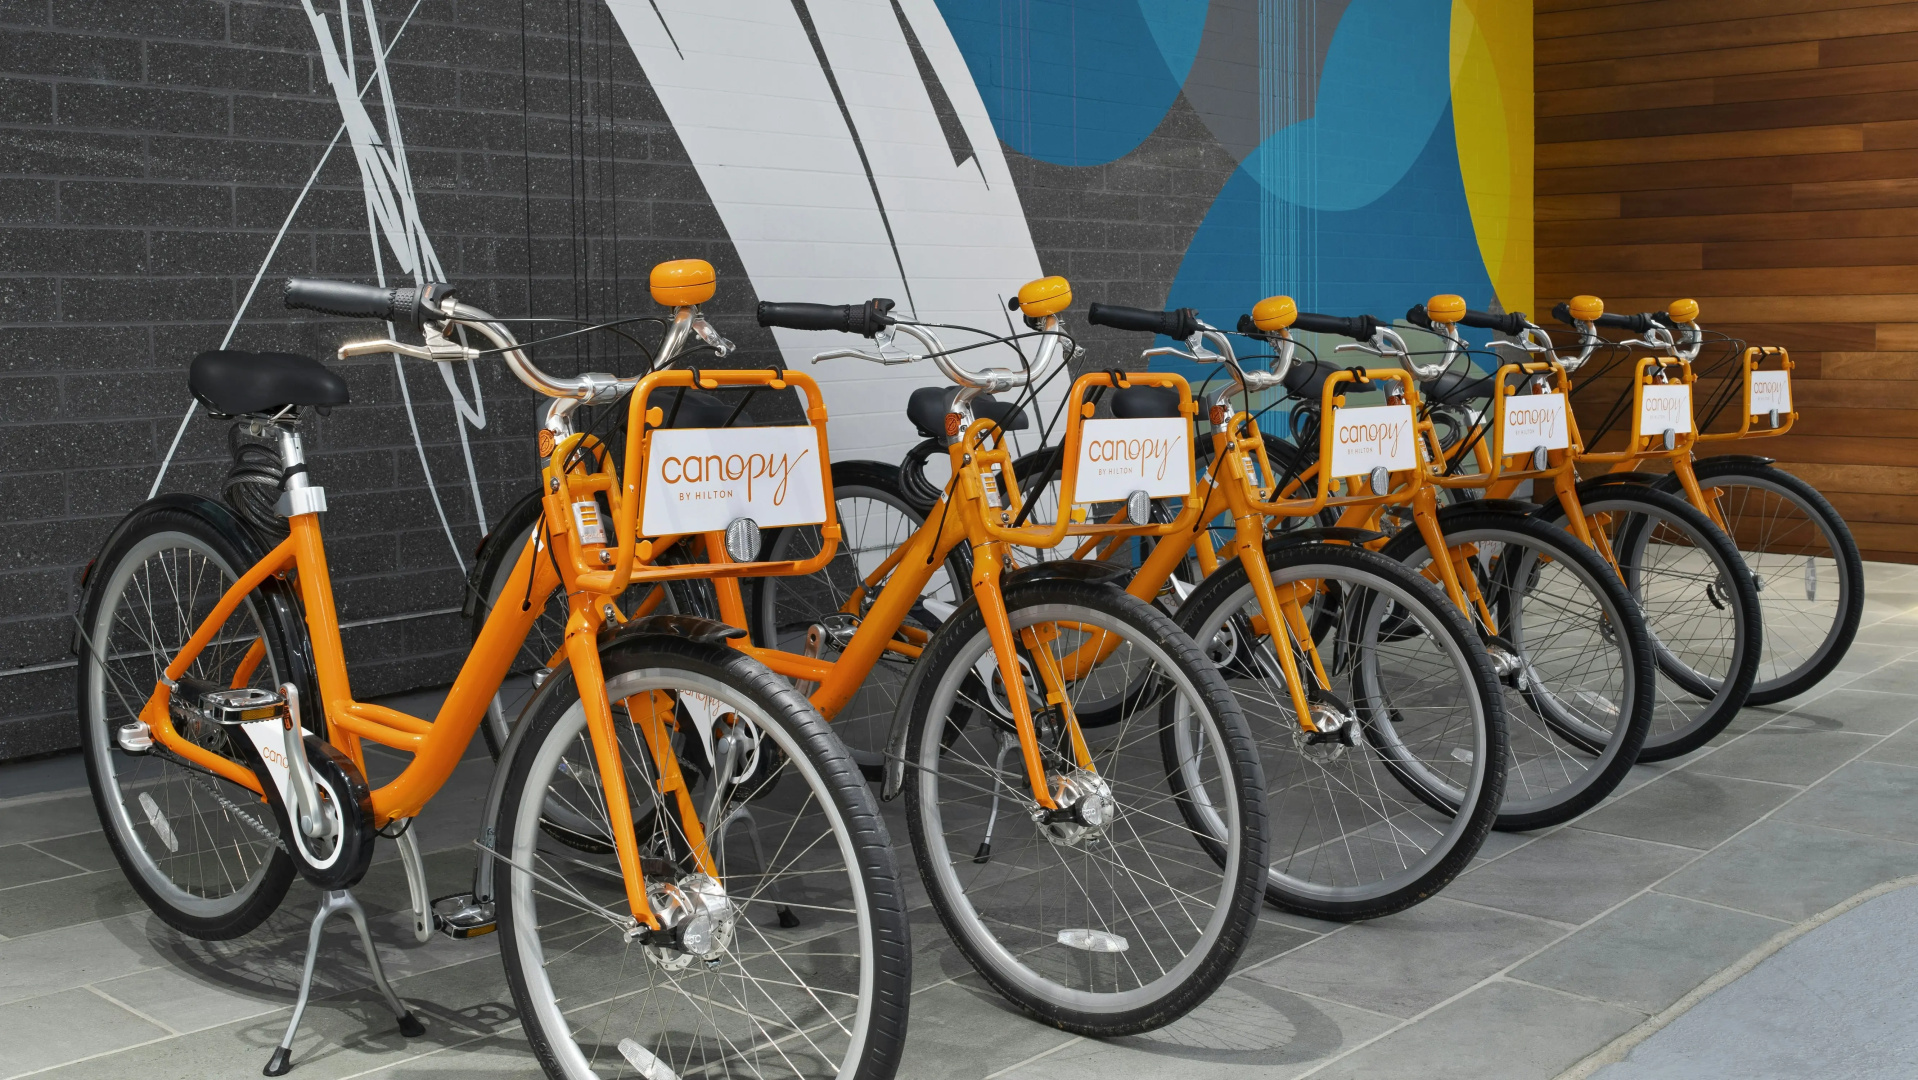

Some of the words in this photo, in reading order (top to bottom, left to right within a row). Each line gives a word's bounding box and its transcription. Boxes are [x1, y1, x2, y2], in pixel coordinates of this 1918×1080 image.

[1509, 406, 1562, 439] canopy
[1646, 396, 1687, 424] canopy
[1339, 419, 1408, 458] canopy
[1088, 435, 1181, 481] canopy
[1098, 468, 1106, 476] BY
[1108, 467, 1133, 475] HILTON
[661, 449, 809, 507] canopy
[679, 492, 691, 501] BY
[695, 490, 734, 500] HILTON
[262, 746, 290, 773] cano
